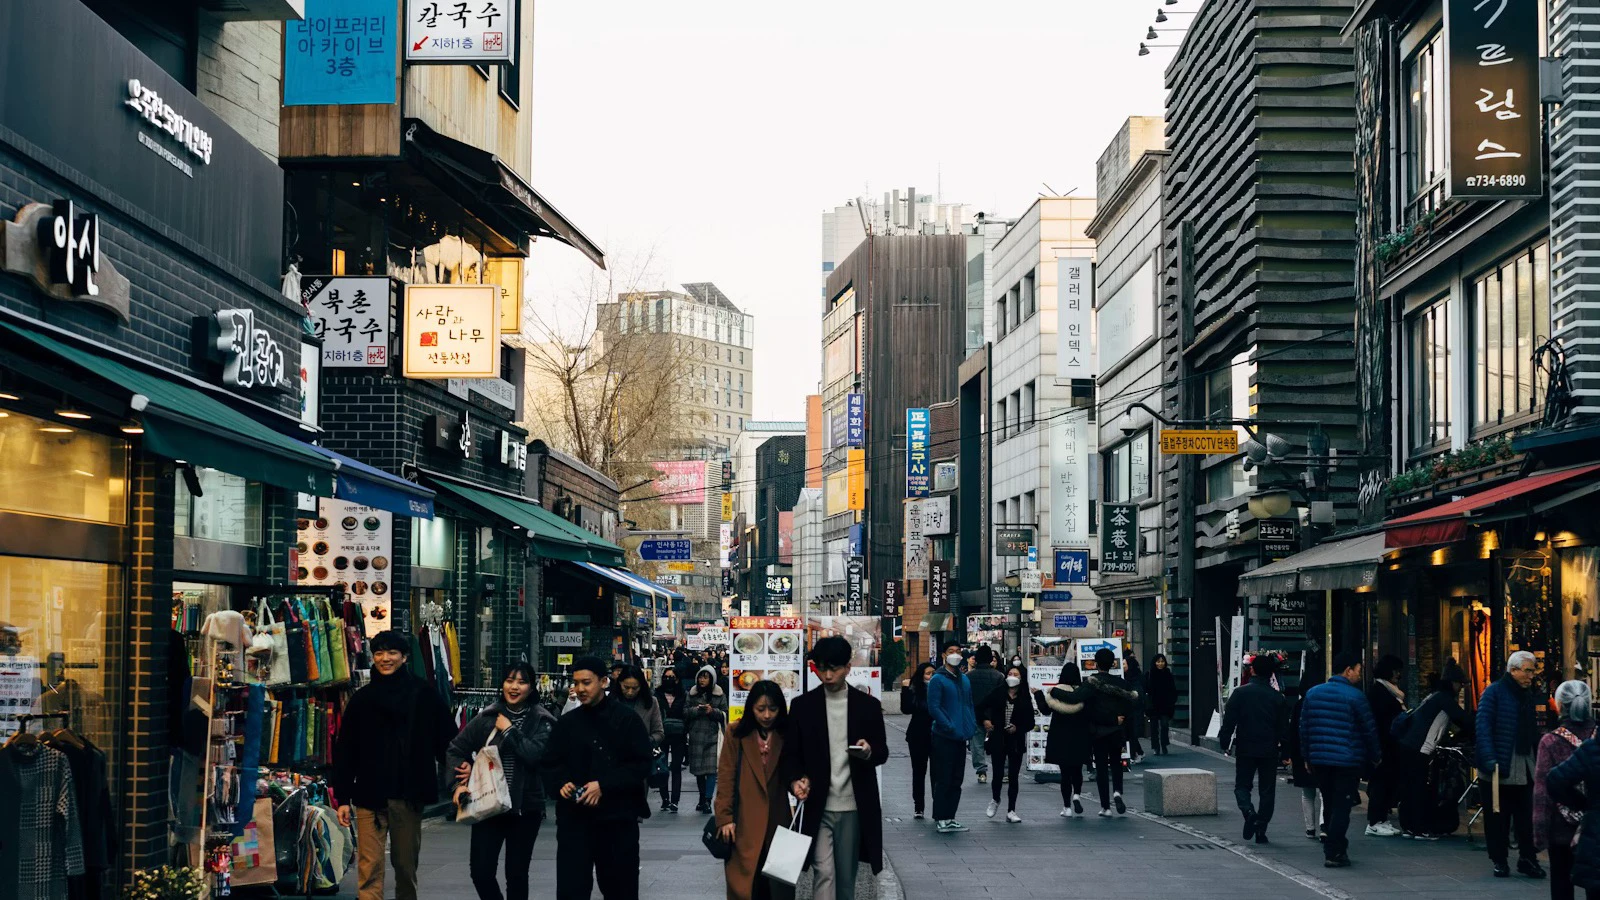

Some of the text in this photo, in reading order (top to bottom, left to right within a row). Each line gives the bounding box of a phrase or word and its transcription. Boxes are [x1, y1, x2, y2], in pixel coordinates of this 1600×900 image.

[417, 2, 502, 29] 칼국수
[297, 16, 386, 36] 라이프러리
[298, 37, 385, 56] 아카이브
[431, 37, 474, 49] 지하1층
[326, 57, 356, 76] 3층
[1476, 174, 1526, 187] 734-6890
[302, 279, 323, 299] 인사동
[321, 289, 371, 314] 북촌
[1068, 267, 1081, 367] 갤러리 인덱스
[314, 317, 382, 343] 칼국수
[449, 328, 485, 343] 나무
[324, 349, 364, 362] 지하1층
[428, 352, 470, 365] 전통찻집
[545, 635, 581, 643] TAL BANG
